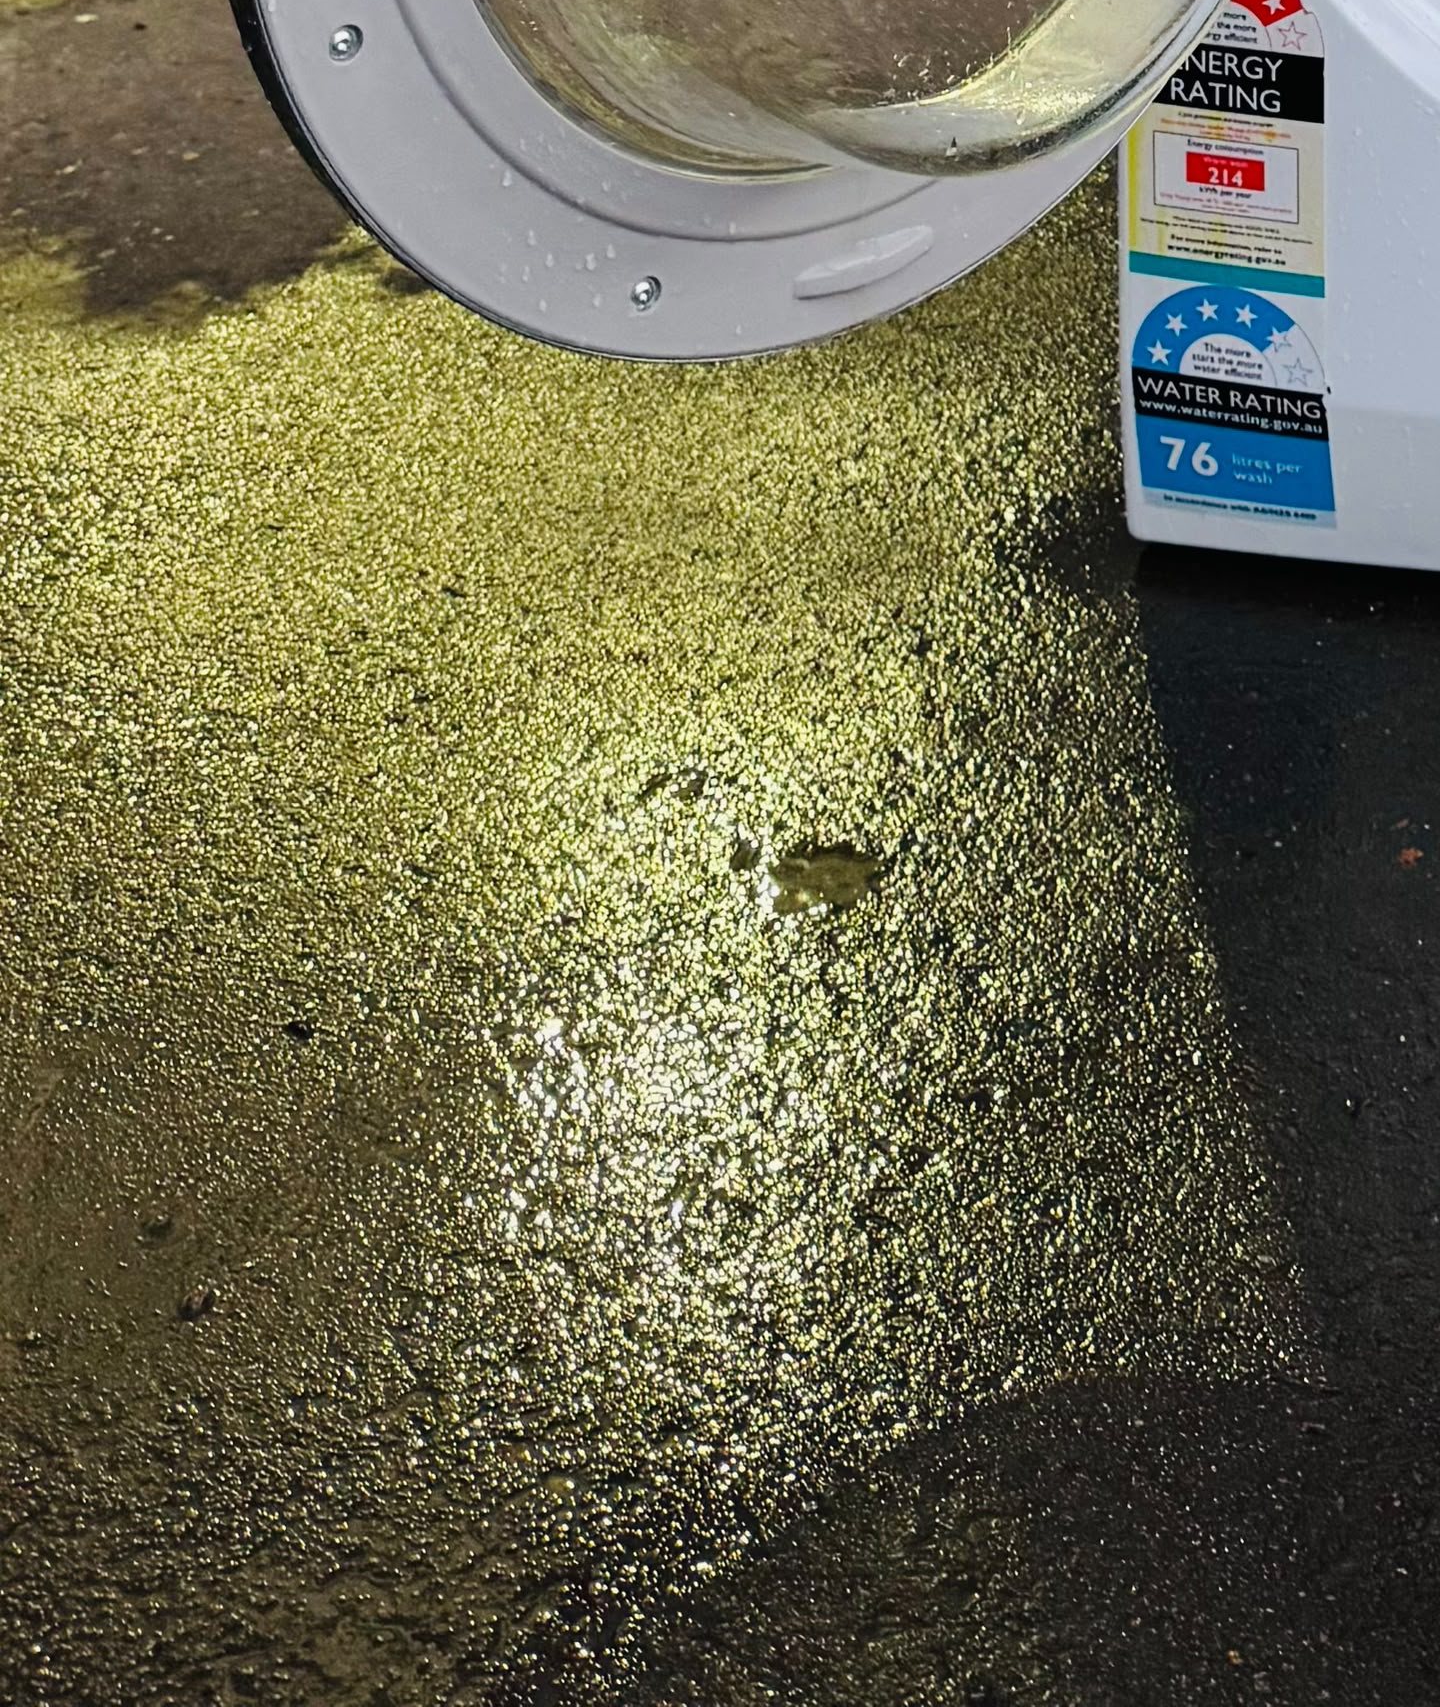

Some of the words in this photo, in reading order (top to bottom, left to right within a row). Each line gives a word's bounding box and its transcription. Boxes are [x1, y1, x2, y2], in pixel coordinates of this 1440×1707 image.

[1233, 24, 1256, 33] more
[1178, 48, 1283, 82] NERGY
[1170, 77, 1281, 113] RATING
[1187, 139, 1212, 150] Energy
[1215, 143, 1264, 155] consumption
[1208, 166, 1243, 187] 214
[1220, 189, 1233, 198] per
[1236, 191, 1252, 199] year
[1204, 342, 1222, 354] The
[1225, 348, 1251, 358] more
[1192, 353, 1215, 364] stars
[1218, 355, 1233, 366] the
[1236, 360, 1263, 370] more
[1193, 364, 1220, 375] water
[1224, 366, 1263, 380] efficient
[1137, 375, 1223, 405] WATER
[1229, 390, 1321, 419] RATING
[1139, 398, 1322, 434] www.waterrating.gov.au
[1160, 435, 1219, 477] 76
[1231, 453, 1271, 470] litres
[1275, 460, 1302, 474] per
[1233, 470, 1274, 485] wash
